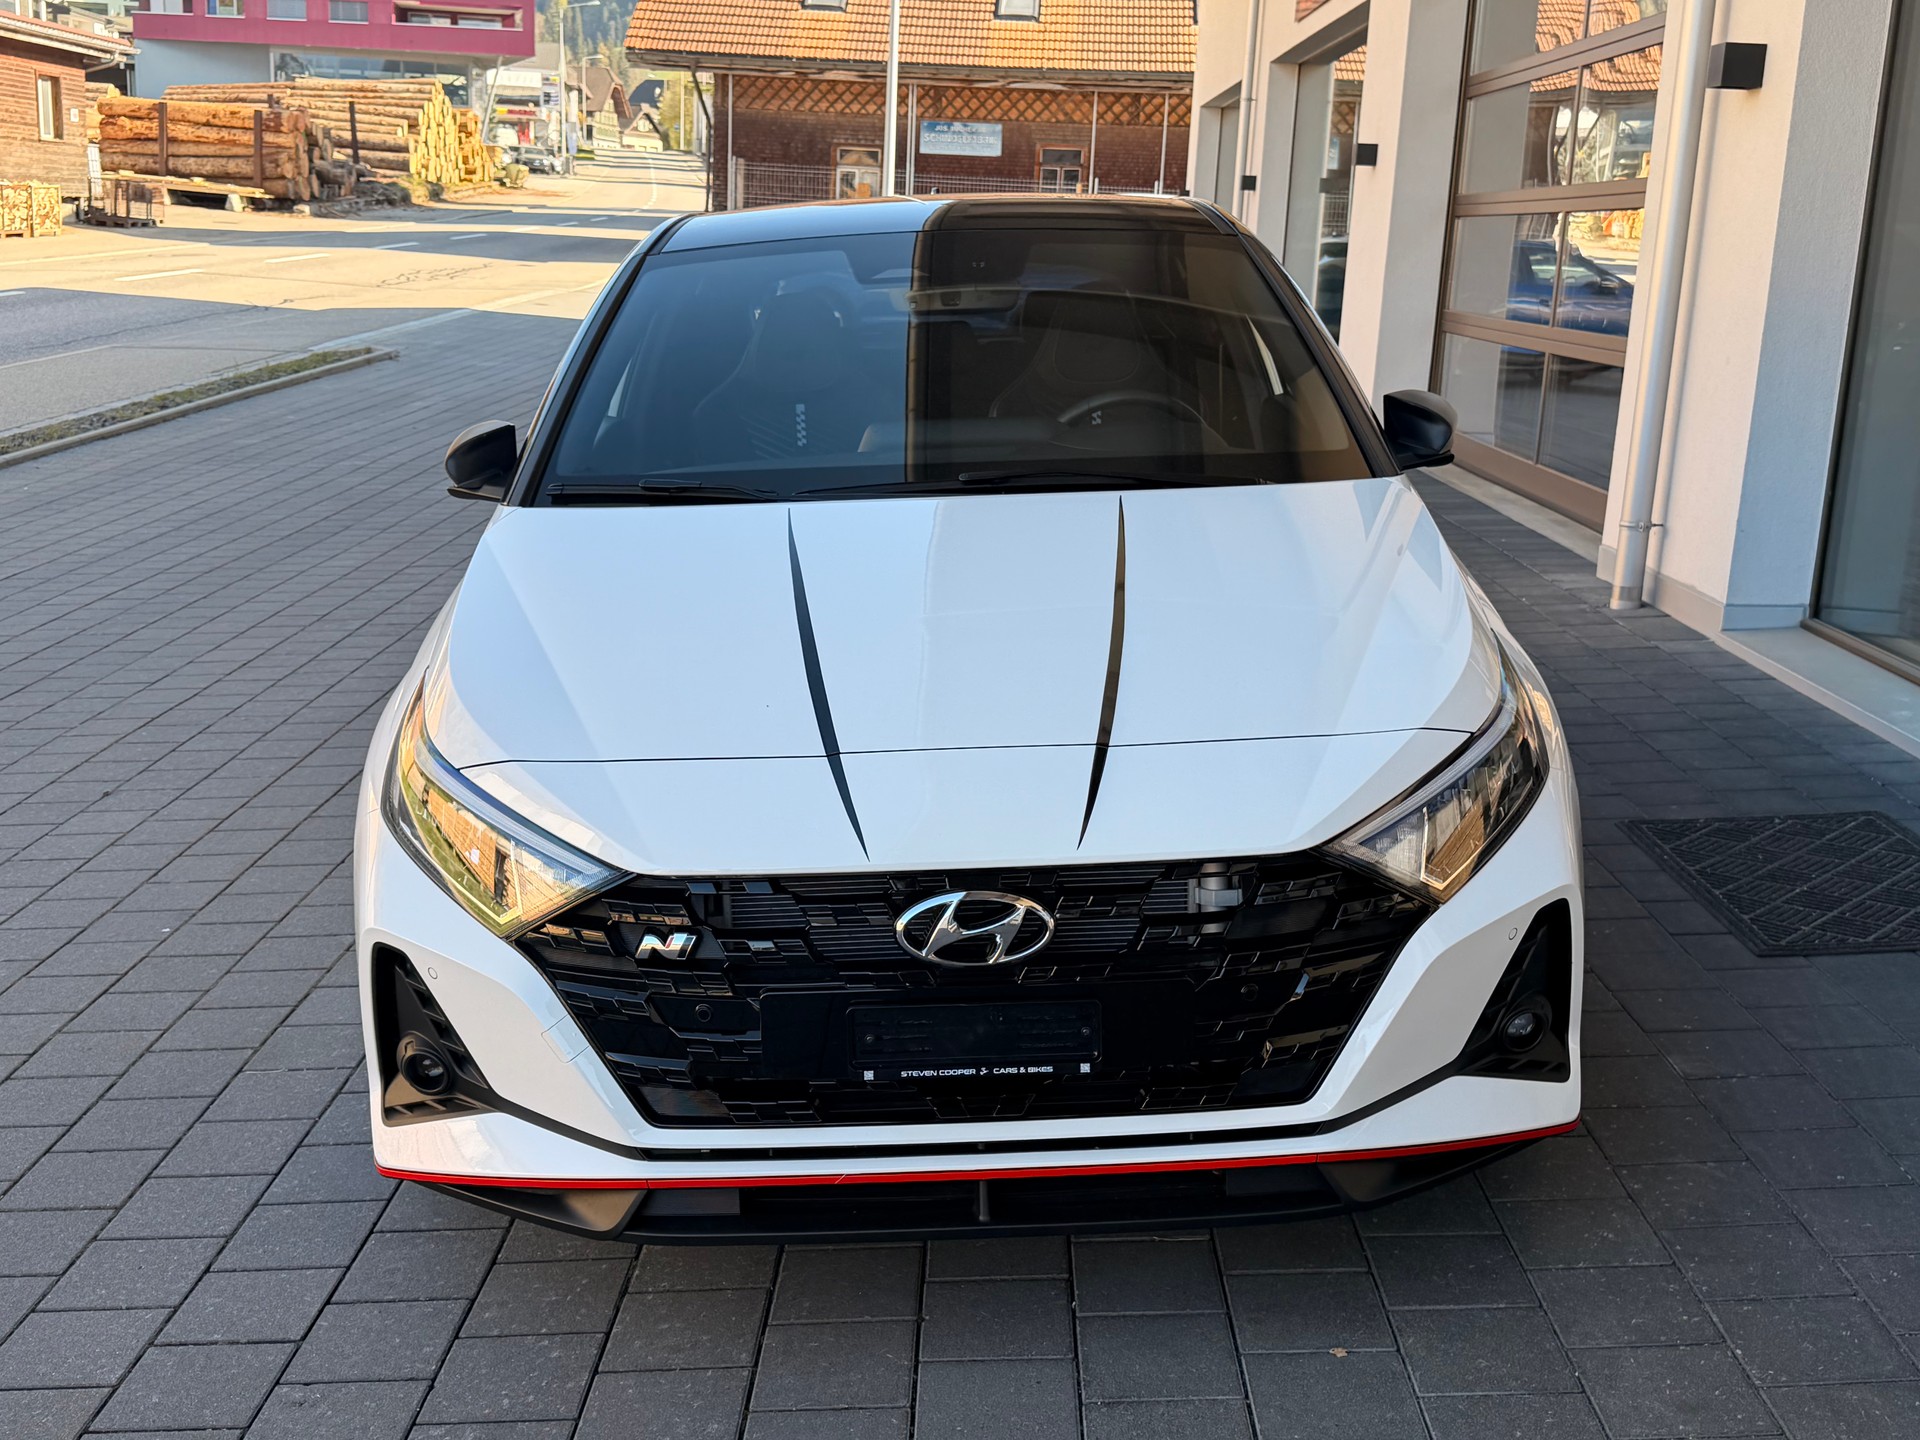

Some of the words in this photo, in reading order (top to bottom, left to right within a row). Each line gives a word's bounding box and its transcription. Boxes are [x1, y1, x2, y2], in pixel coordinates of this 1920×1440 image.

[900, 1069, 938, 1078] STEVEN
[938, 1068, 977, 1077] COOPER
[993, 1066, 1018, 1074] CARS
[1019, 1065, 1026, 1073] &
[1027, 1065, 1054, 1074] BIKES
